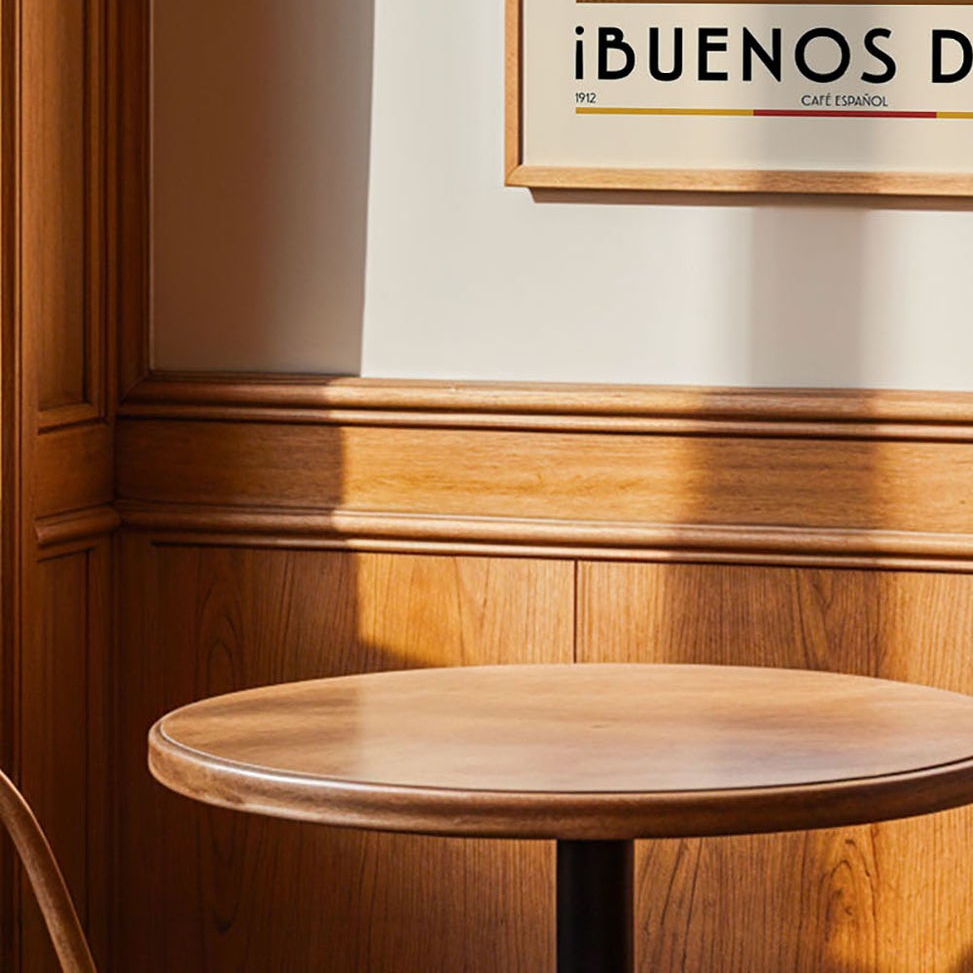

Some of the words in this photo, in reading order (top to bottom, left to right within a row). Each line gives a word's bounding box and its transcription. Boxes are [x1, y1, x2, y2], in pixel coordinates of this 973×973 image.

[575, 25, 897, 84] ¡BUENOS
[575, 92, 597, 104] 1912
[800, 92, 832, 107] CAFÉ
[834, 92, 889, 107] ESPAÑOL
